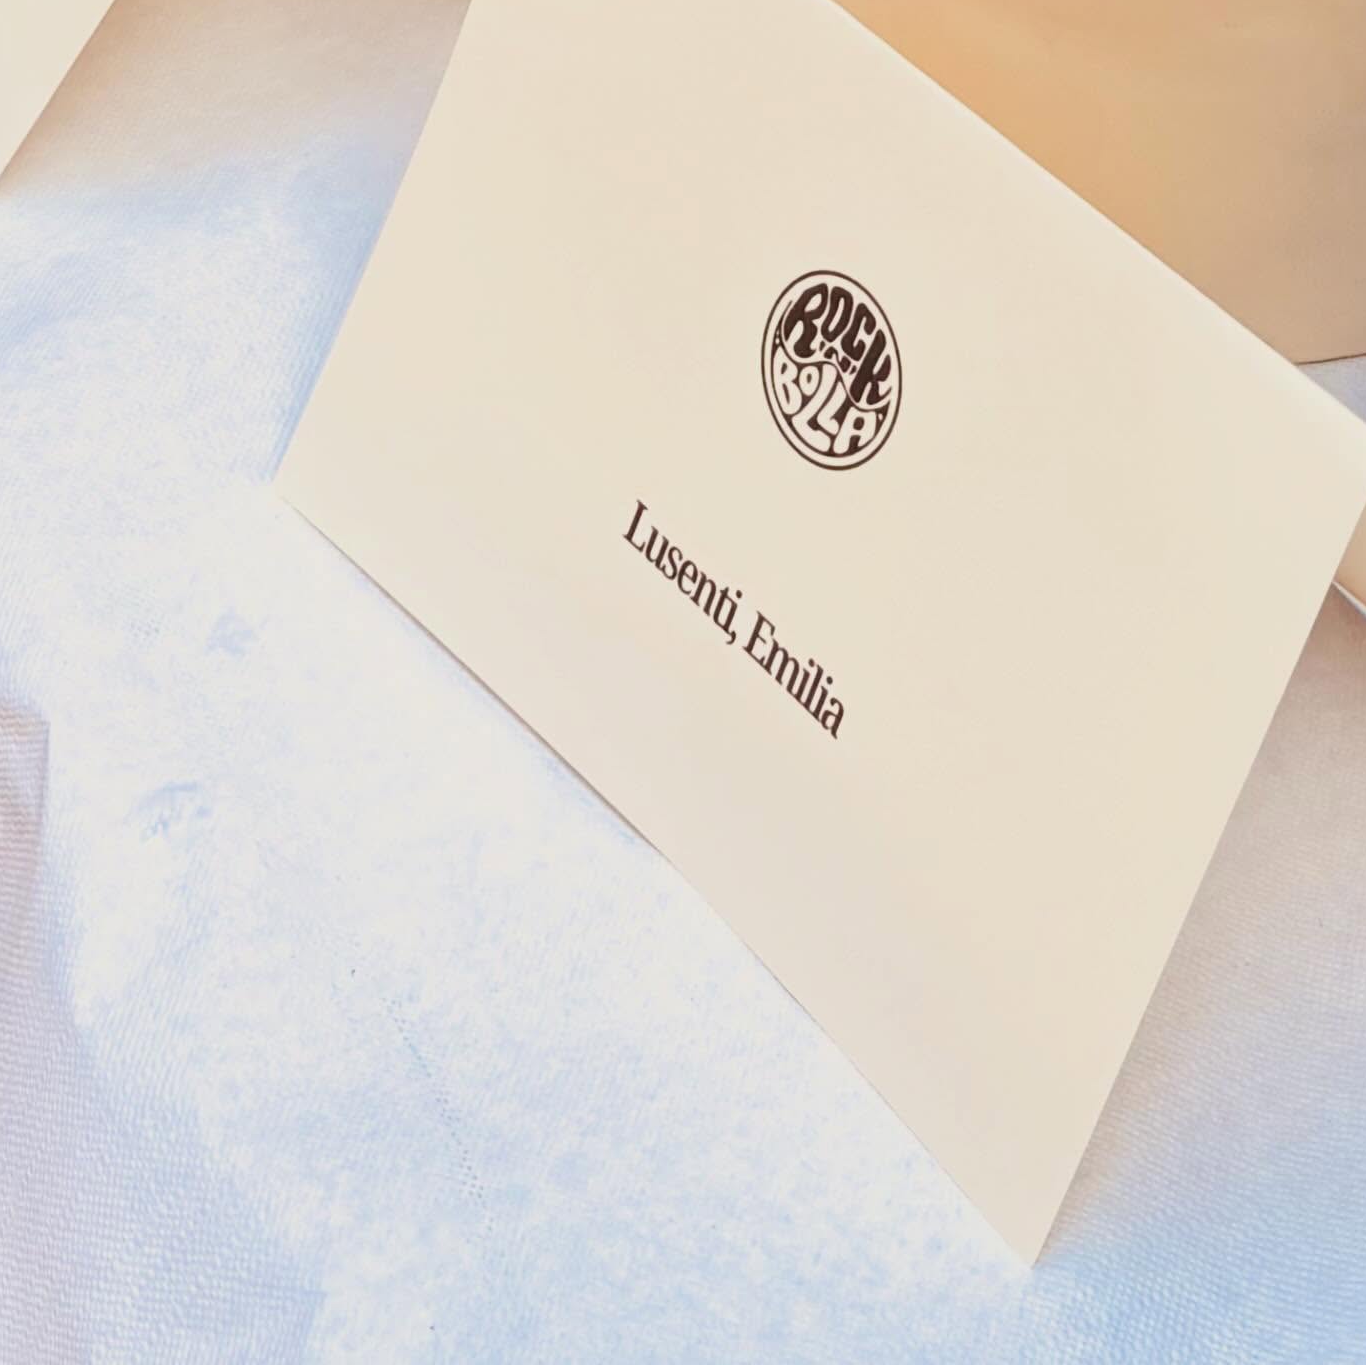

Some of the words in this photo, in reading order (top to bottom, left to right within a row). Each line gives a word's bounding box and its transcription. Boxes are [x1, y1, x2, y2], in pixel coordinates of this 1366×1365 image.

[784, 283, 893, 406] ROCK
[623, 499, 743, 645] Lusenti,
[742, 611, 845, 740] Emilia
